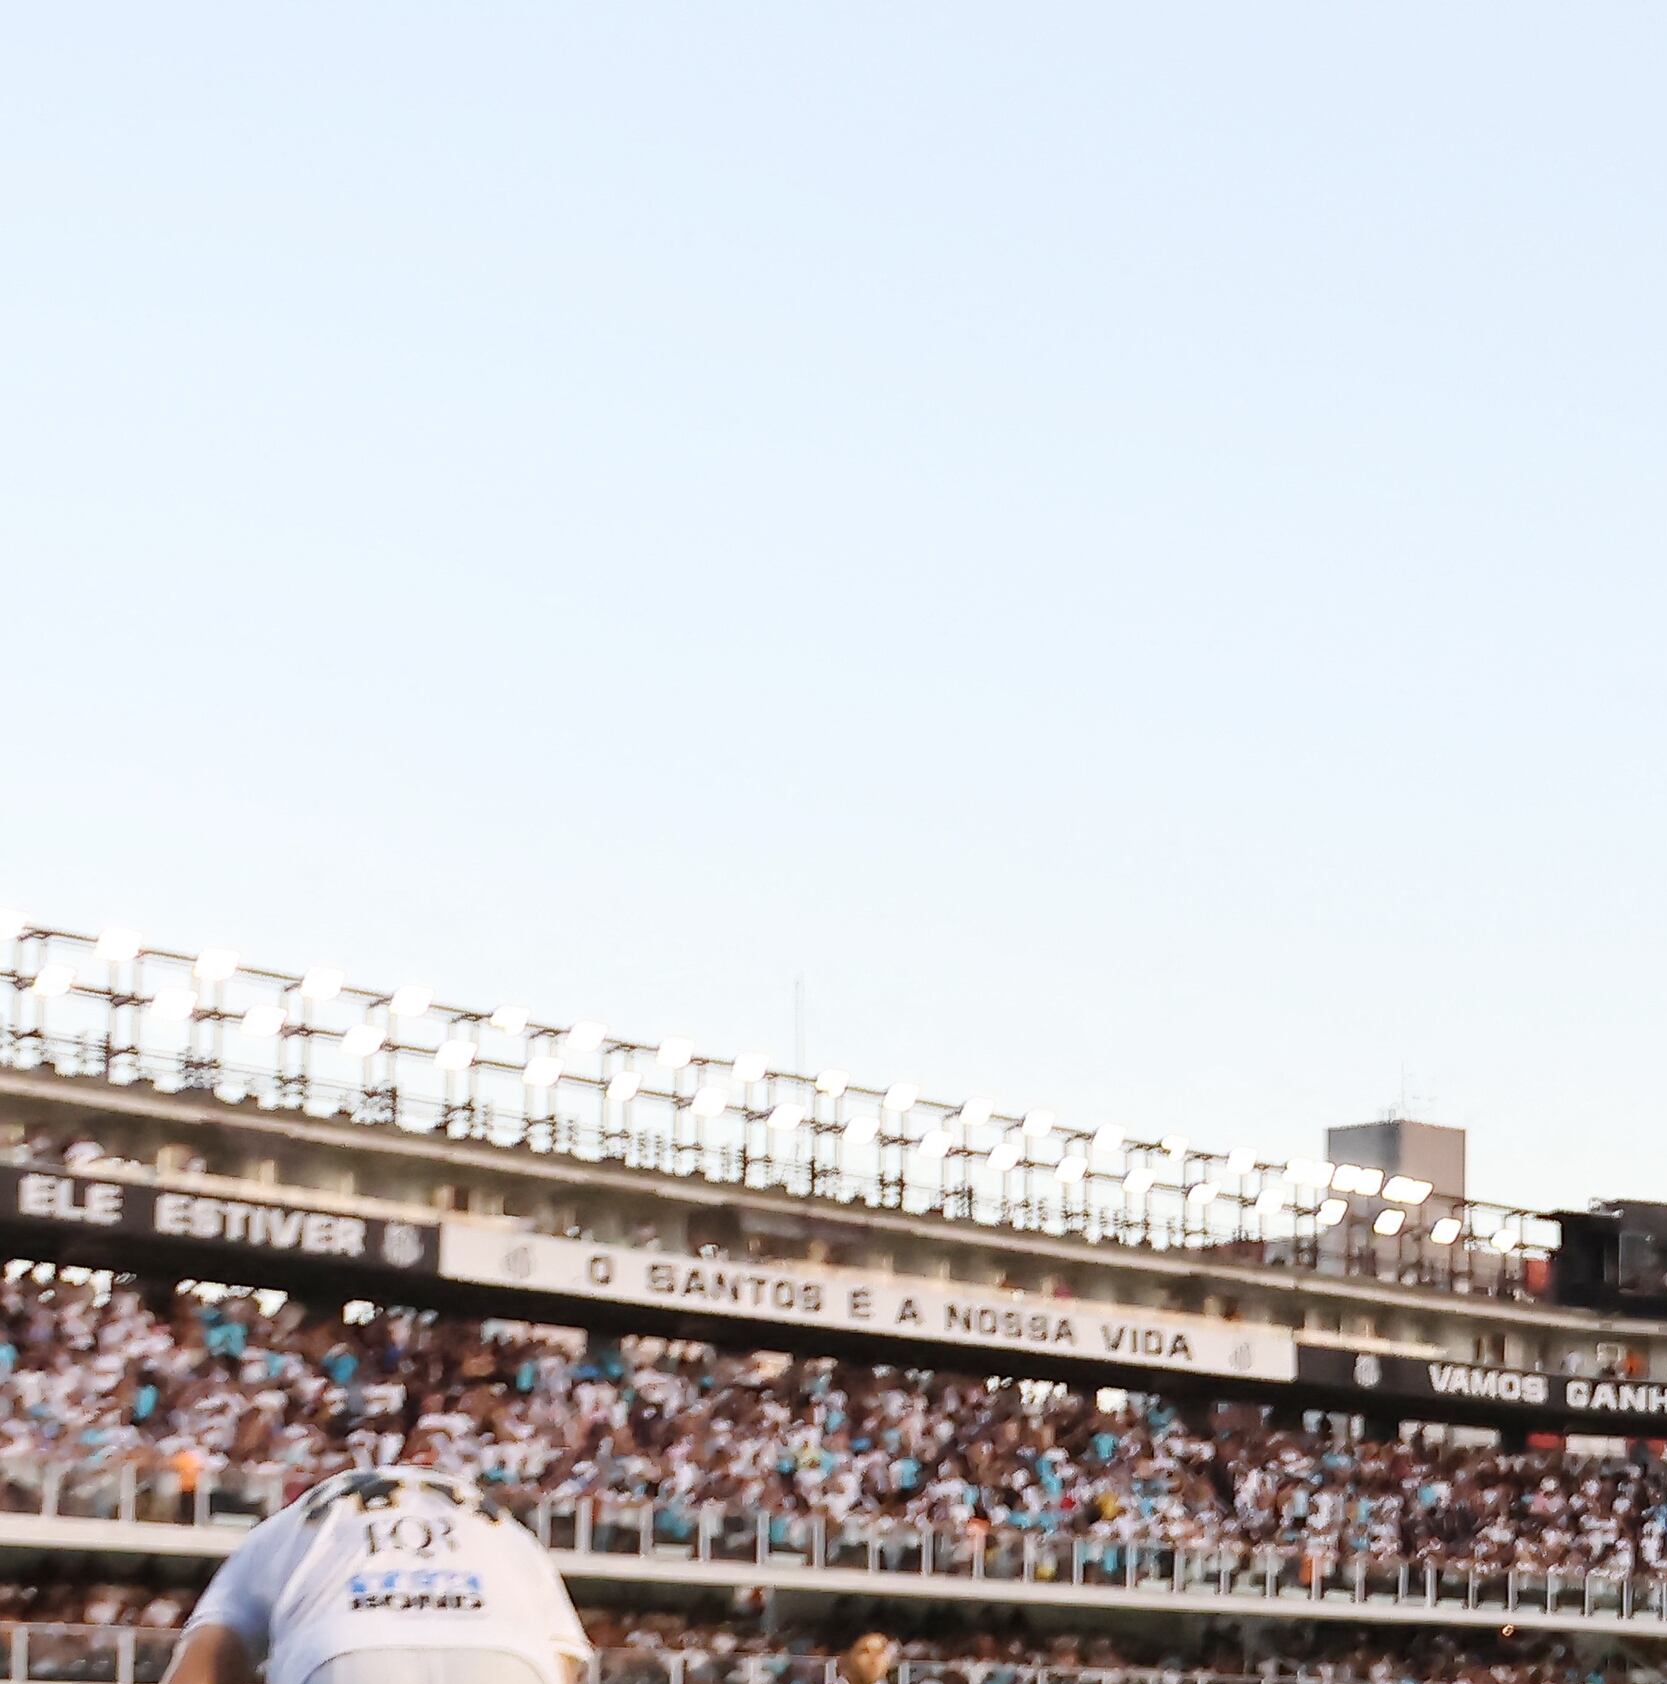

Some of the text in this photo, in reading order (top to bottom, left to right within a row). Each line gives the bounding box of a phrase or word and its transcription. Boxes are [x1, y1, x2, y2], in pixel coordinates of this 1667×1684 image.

[17, 1172, 367, 1259] ELE ESTIVER
[590, 1254, 612, 1284] O
[647, 1263, 823, 1313] SANTOS
[895, 1298, 925, 1327] A
[943, 1301, 1075, 1346] NOSSA
[1101, 1322, 1194, 1362] VIDA
[1429, 1363, 1548, 1403] VAMOS
